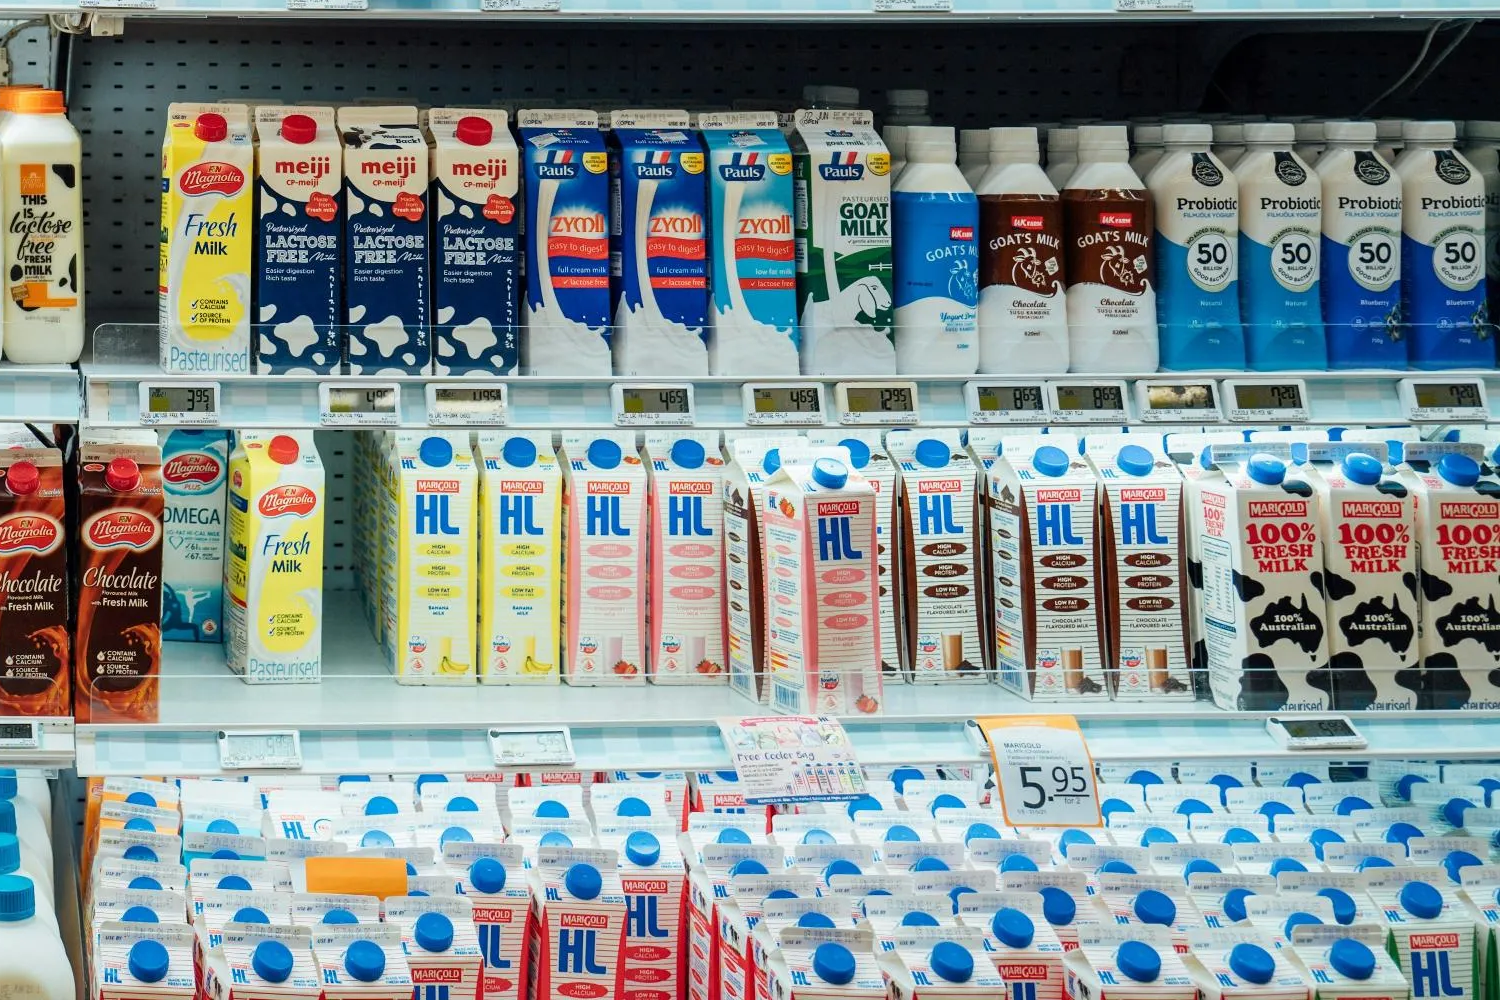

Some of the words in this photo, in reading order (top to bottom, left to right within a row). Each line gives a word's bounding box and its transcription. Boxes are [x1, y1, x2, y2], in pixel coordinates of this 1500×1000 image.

[275, 156, 331, 179] meiji
[539, 164, 575, 176] Pauls
[286, 178, 319, 188] CP-meiji
[840, 203, 889, 220] GOAT
[1177, 197, 1238, 211] Probiotic
[184, 213, 238, 239] Fresh
[840, 220, 889, 236] MILK
[266, 235, 337, 250] LACTOSE
[1124, 231, 1149, 248] MILK
[194, 241, 228, 256] Milk
[266, 250, 308, 263] FREE
[1196, 243, 1227, 264] 50
[286, 268, 315, 276] digestion
[557, 266, 569, 274] full
[592, 266, 606, 274] milk
[1100, 298, 1136, 307] Chocolate
[170, 346, 248, 372] Pasteurised
[416, 481, 459, 492] MARIGOLD
[416, 495, 460, 535] HL
[1249, 502, 1307, 518] MARIGOLD
[1038, 504, 1084, 546] HL
[1246, 522, 1316, 545] 100%
[1252, 544, 1314, 561] FRESH
[1258, 557, 1309, 573] MILK
[82, 565, 158, 590] Chocolate
[102, 598, 125, 607] Fresh
[127, 598, 148, 608] Milk
[1260, 622, 1316, 632] Australian
[1274, 614, 1303, 624] 100%
[1019, 766, 1088, 809] 5.95
[281, 821, 311, 840] HL
[562, 914, 607, 927] MARIGOLD
[1411, 934, 1458, 947] MARIGOLD
[558, 929, 606, 975] HL
[1412, 950, 1464, 998] HL
